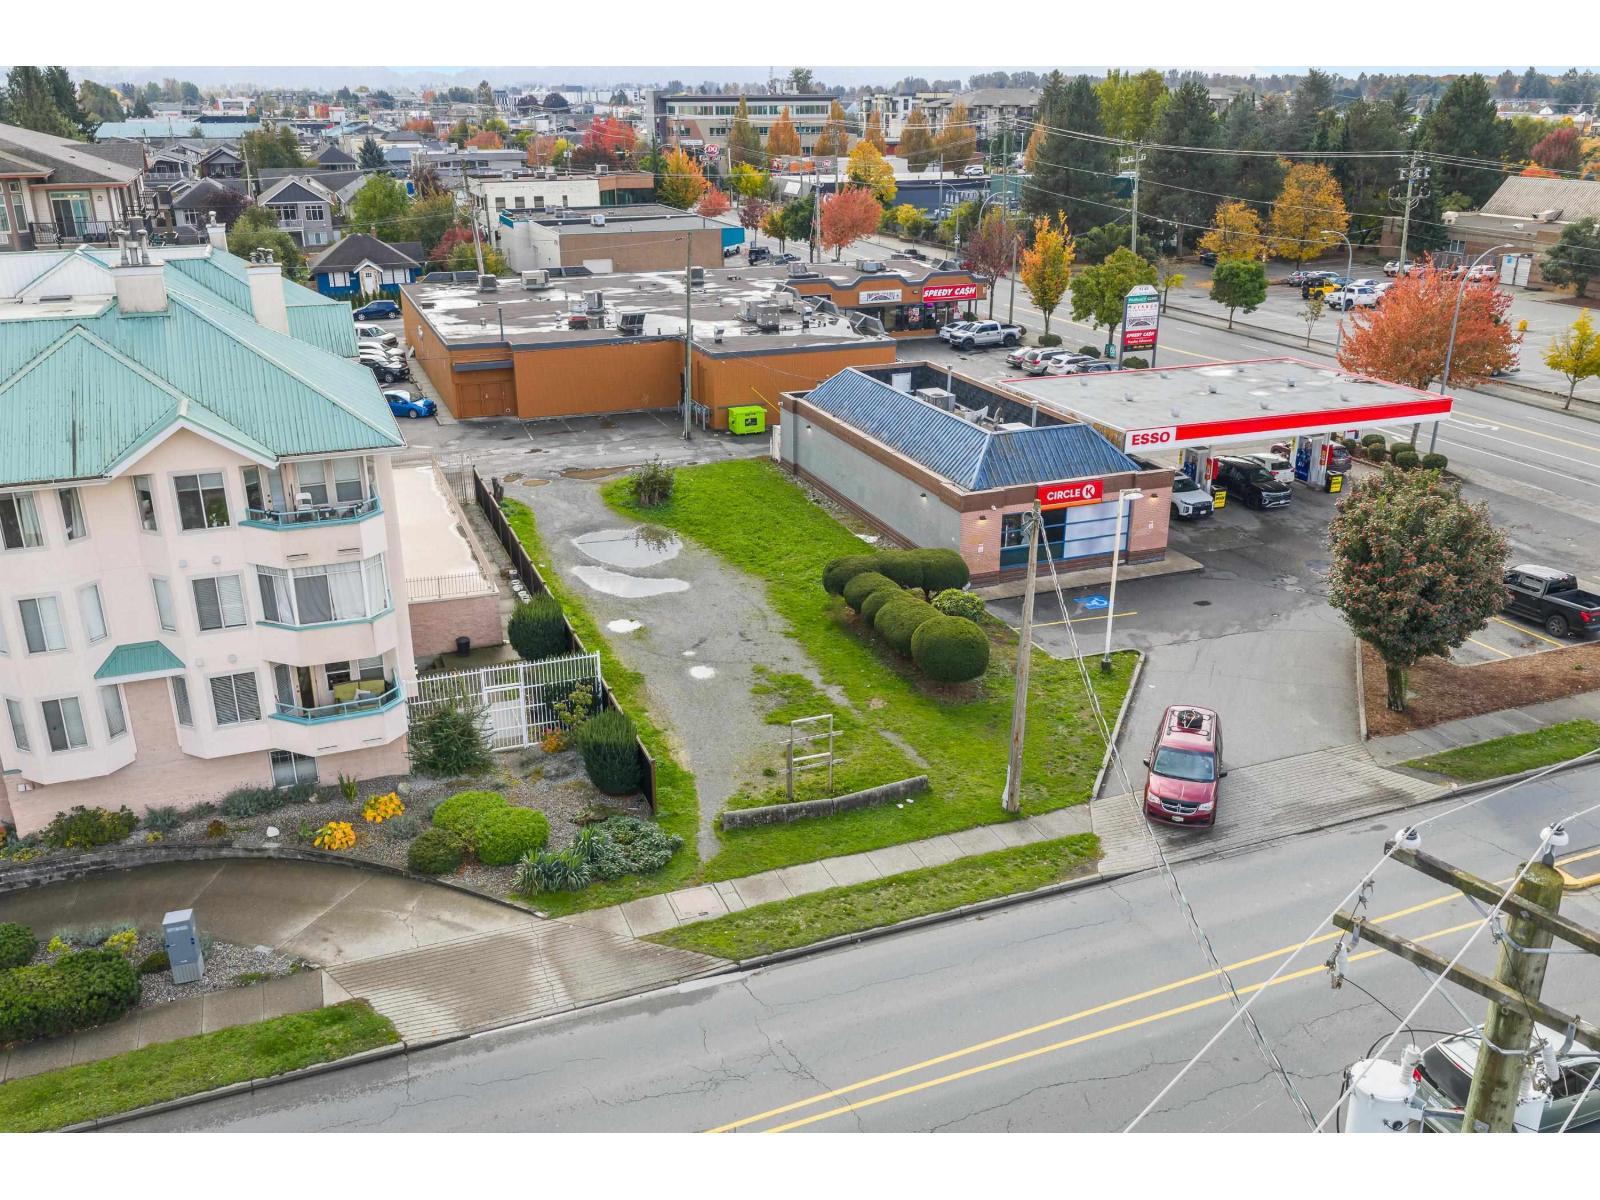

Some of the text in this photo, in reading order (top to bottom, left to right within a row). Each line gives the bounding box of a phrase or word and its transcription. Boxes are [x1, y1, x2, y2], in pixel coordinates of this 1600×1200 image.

[923, 288, 952, 298] SPEEDY
[1131, 431, 1170, 446] ESSO
[1046, 485, 1095, 501] CIRCLE K
